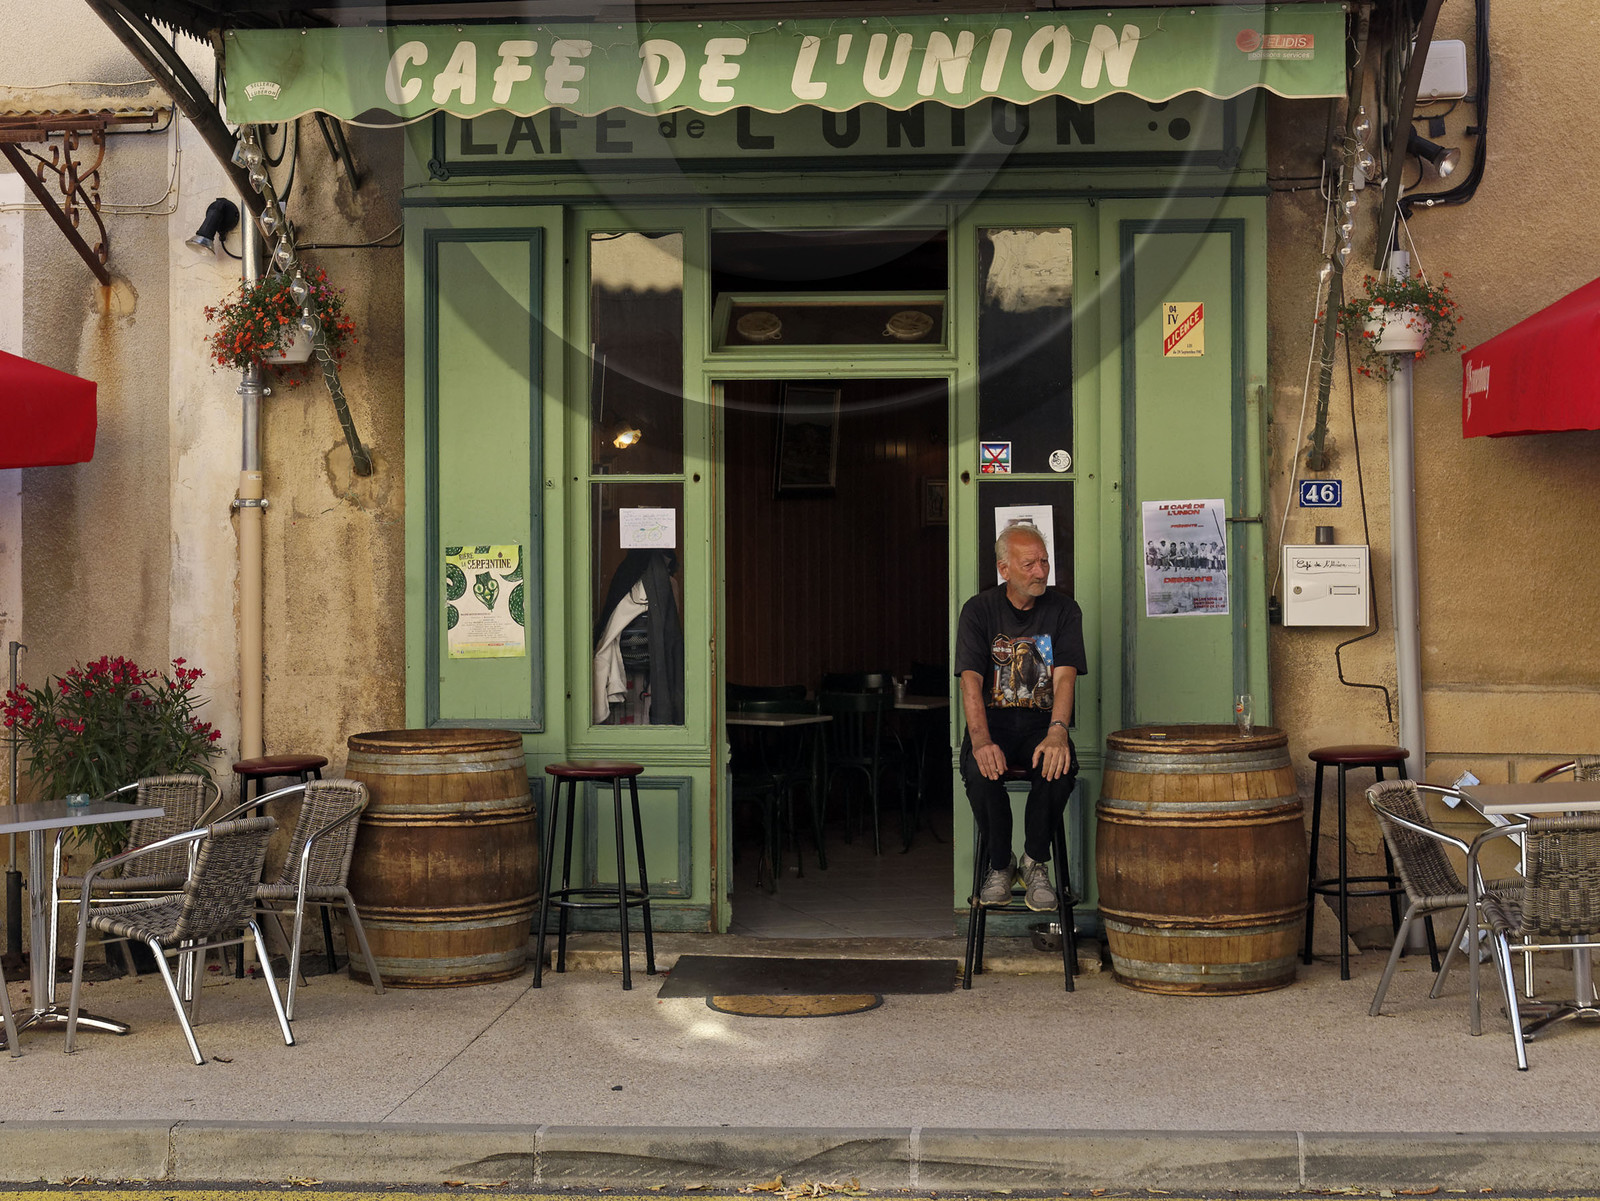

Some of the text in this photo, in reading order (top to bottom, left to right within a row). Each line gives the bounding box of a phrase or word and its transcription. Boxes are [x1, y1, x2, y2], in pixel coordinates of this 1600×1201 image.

[385, 23, 1140, 104] CAFE DE L'UNION
[658, 110, 705, 139] de
[1167, 309, 1200, 350] LICENCE
[1168, 314, 1179, 325] IV
[1305, 484, 1335, 503] 46
